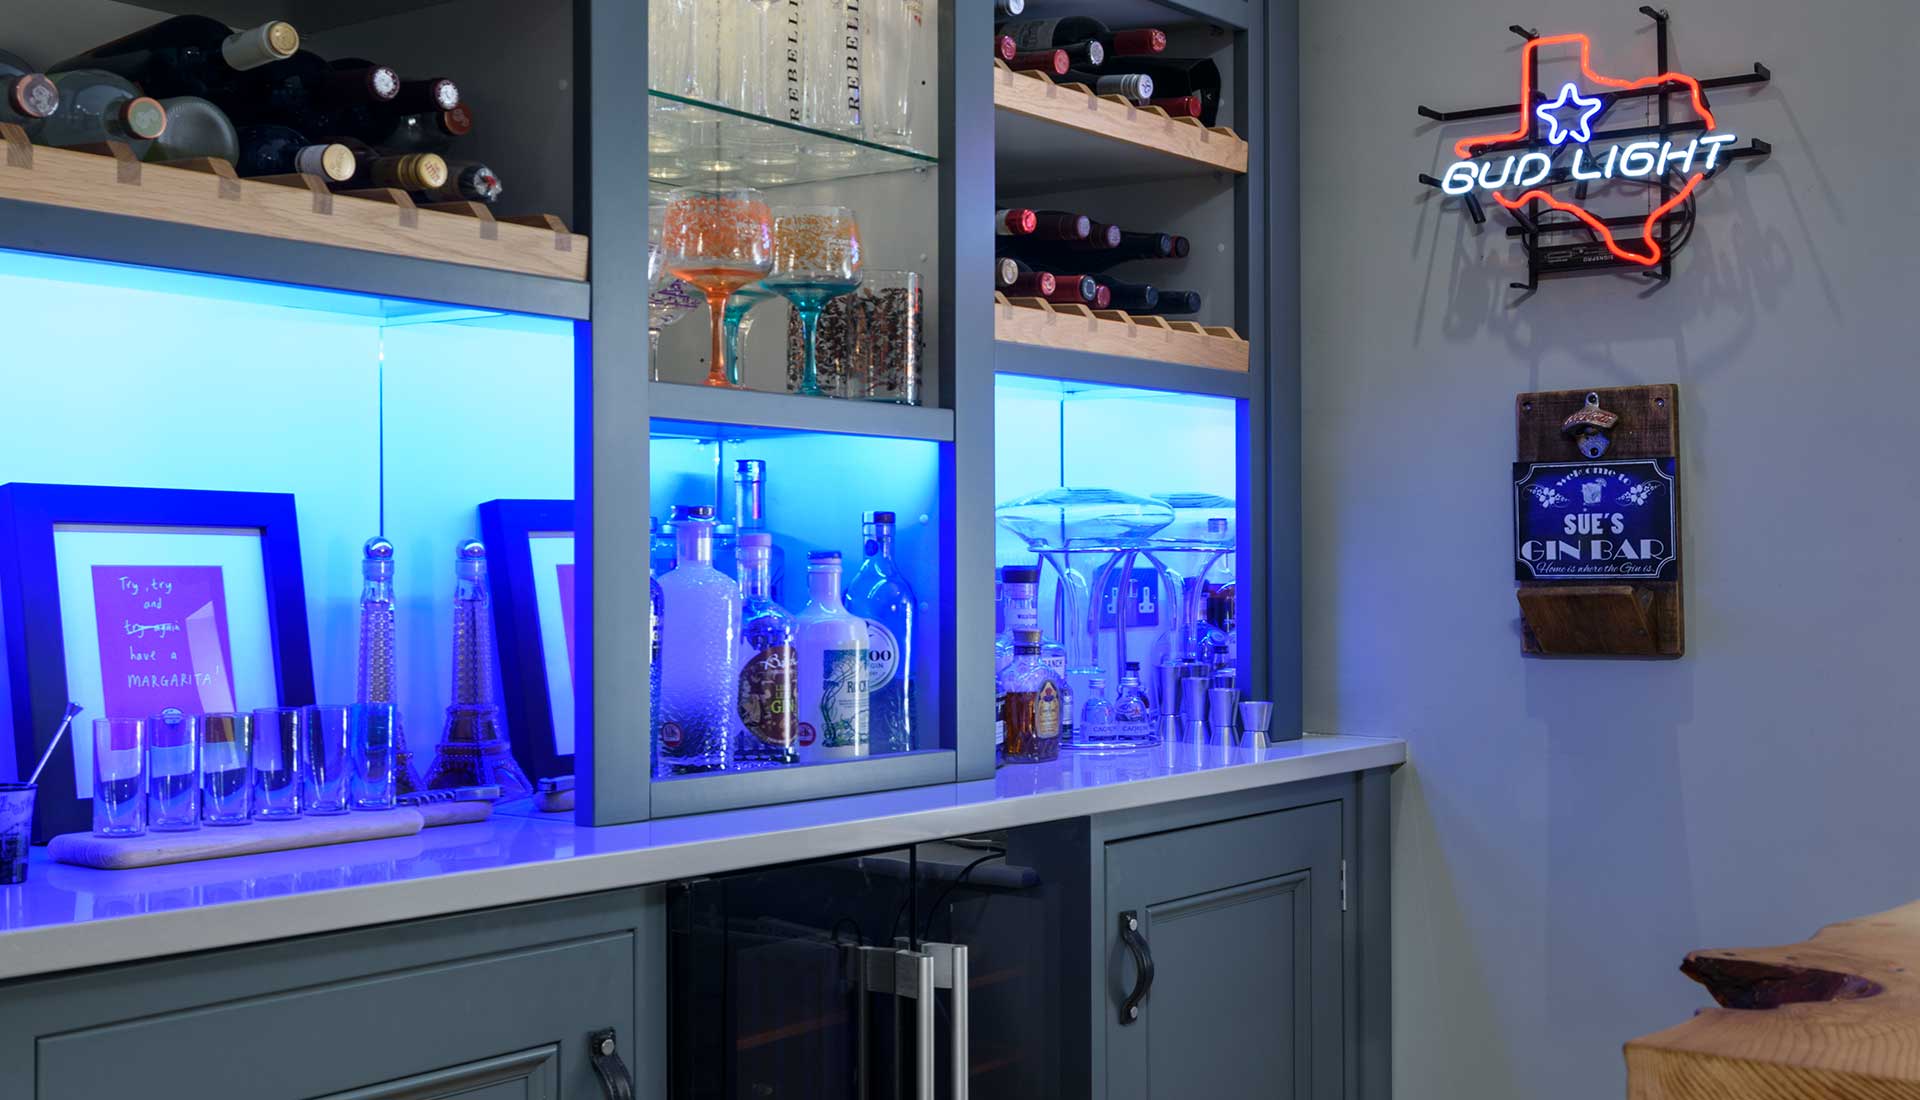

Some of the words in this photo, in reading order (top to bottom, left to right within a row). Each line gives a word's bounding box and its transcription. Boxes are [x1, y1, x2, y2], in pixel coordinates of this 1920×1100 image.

[1442, 152, 1550, 195] BUD
[1571, 134, 1736, 180] LIGHT
[1563, 512, 1625, 535] SUE'S
[1521, 539, 1581, 562] GIN
[1590, 538, 1665, 561] BAR
[1536, 562, 1566, 574] Home
[1567, 565, 1576, 573] is
[1577, 563, 1603, 573] where
[1604, 562, 1619, 573] the
[1619, 561, 1642, 574] Gin
[151, 578, 173, 594] try
[143, 597, 162, 609] and
[129, 645, 156, 661] have
[170, 651, 177, 660] a
